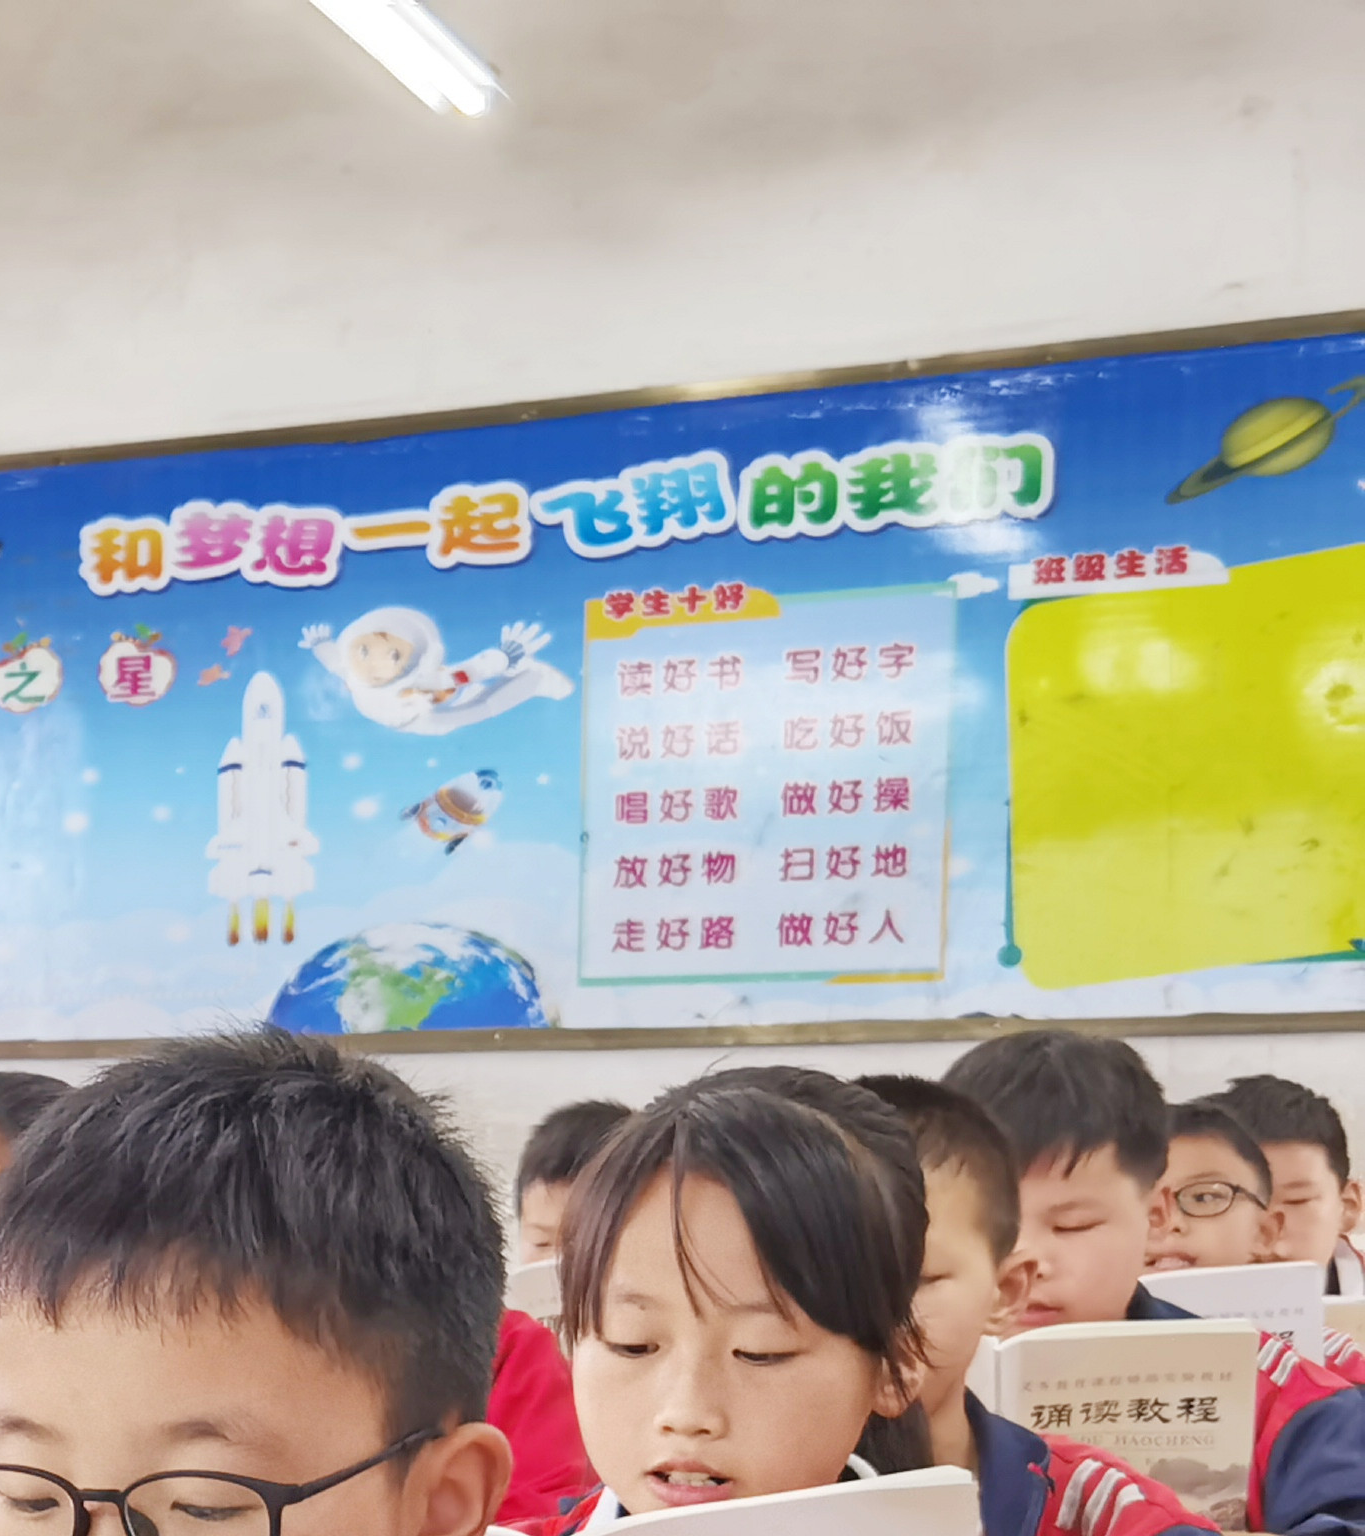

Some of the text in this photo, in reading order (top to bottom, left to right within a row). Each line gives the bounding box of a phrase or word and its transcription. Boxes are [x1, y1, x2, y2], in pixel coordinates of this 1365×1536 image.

[84, 440, 1047, 588] 和梦想一起飞翔的我们
[1032, 546, 1189, 584] 班级生活
[603, 582, 746, 618] 学生十好
[616, 642, 915, 697] 读好书 写好字
[615, 710, 913, 761] 说好话 吃好饭
[615, 776, 911, 824] 唱好歌 做好操
[612, 843, 908, 889] 放好物 扫好地
[610, 907, 905, 954] 走好路 做好人
[1029, 1396, 1221, 1429] 诵读教程
